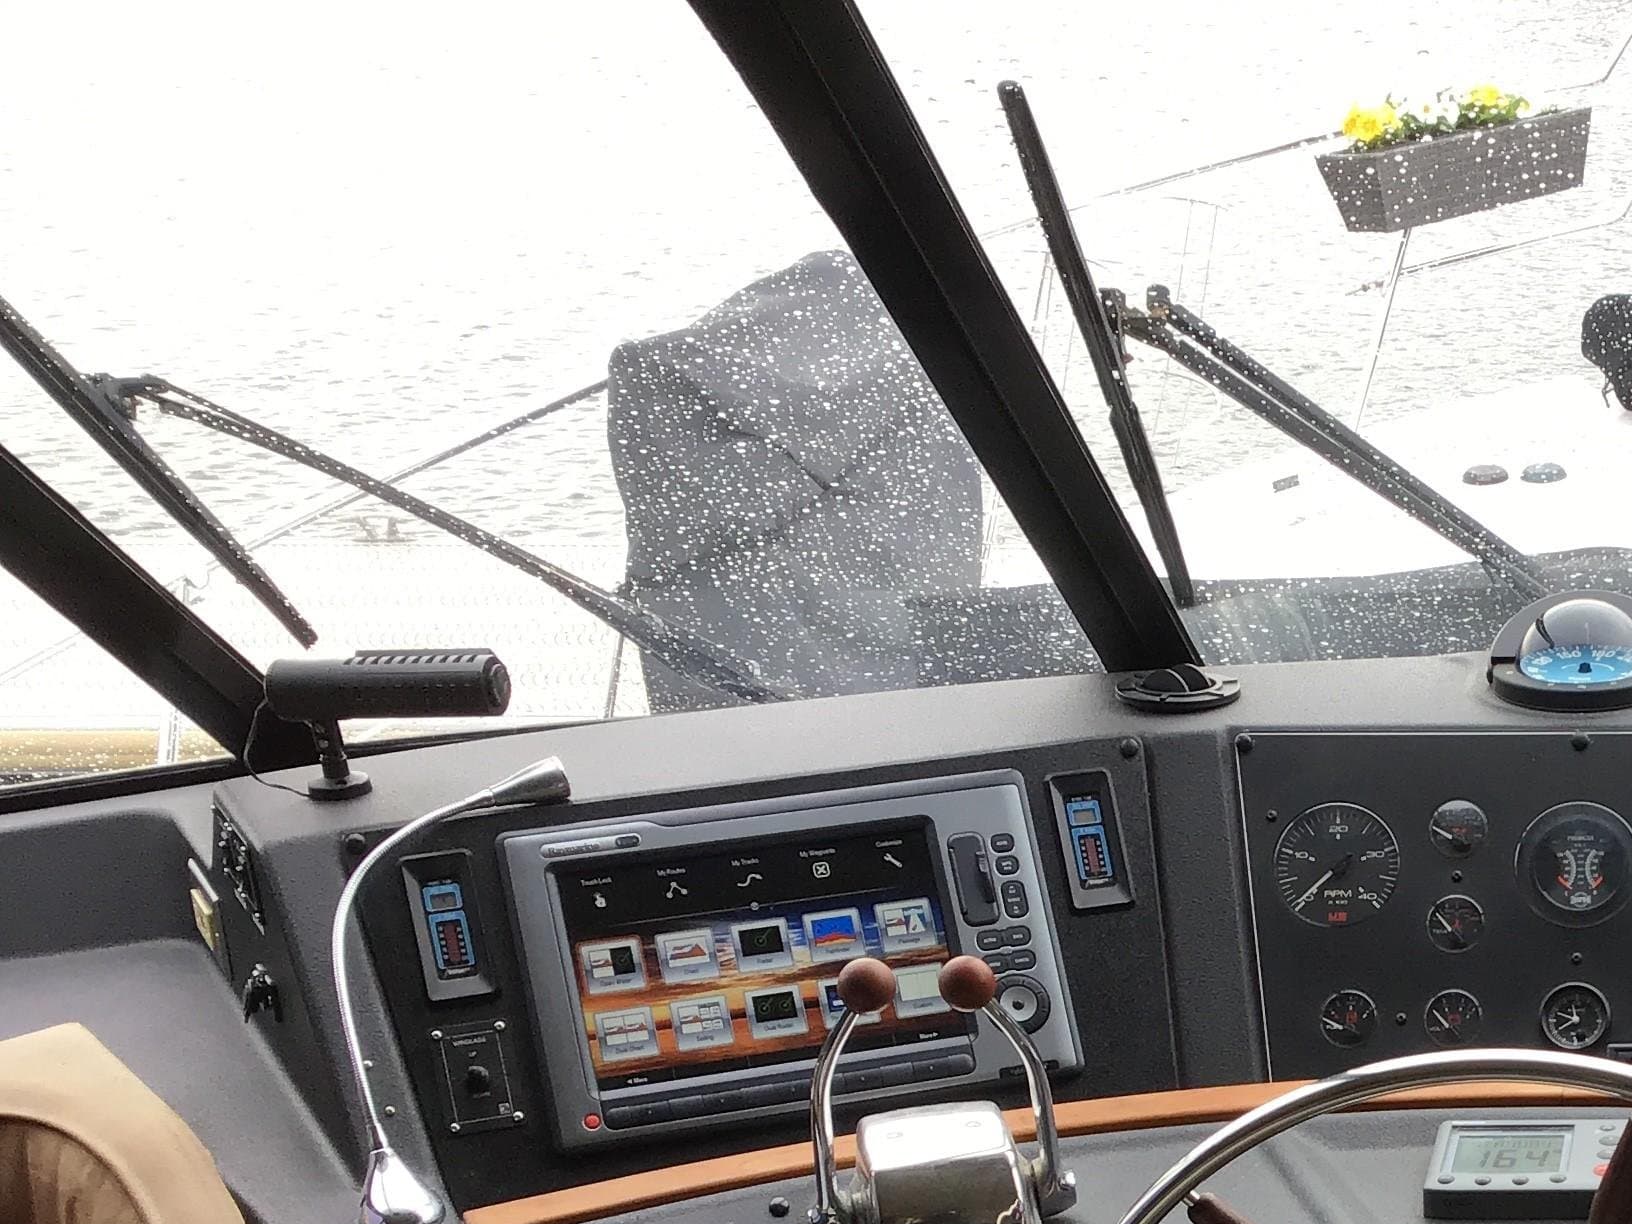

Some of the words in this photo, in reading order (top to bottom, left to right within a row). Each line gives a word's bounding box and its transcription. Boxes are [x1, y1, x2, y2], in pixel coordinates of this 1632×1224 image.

[1328, 825, 1349, 833] 20
[1294, 851, 1309, 859] 10
[1366, 850, 1385, 858] 30
[1323, 890, 1353, 898] RPM
[1358, 892, 1378, 901] 40
